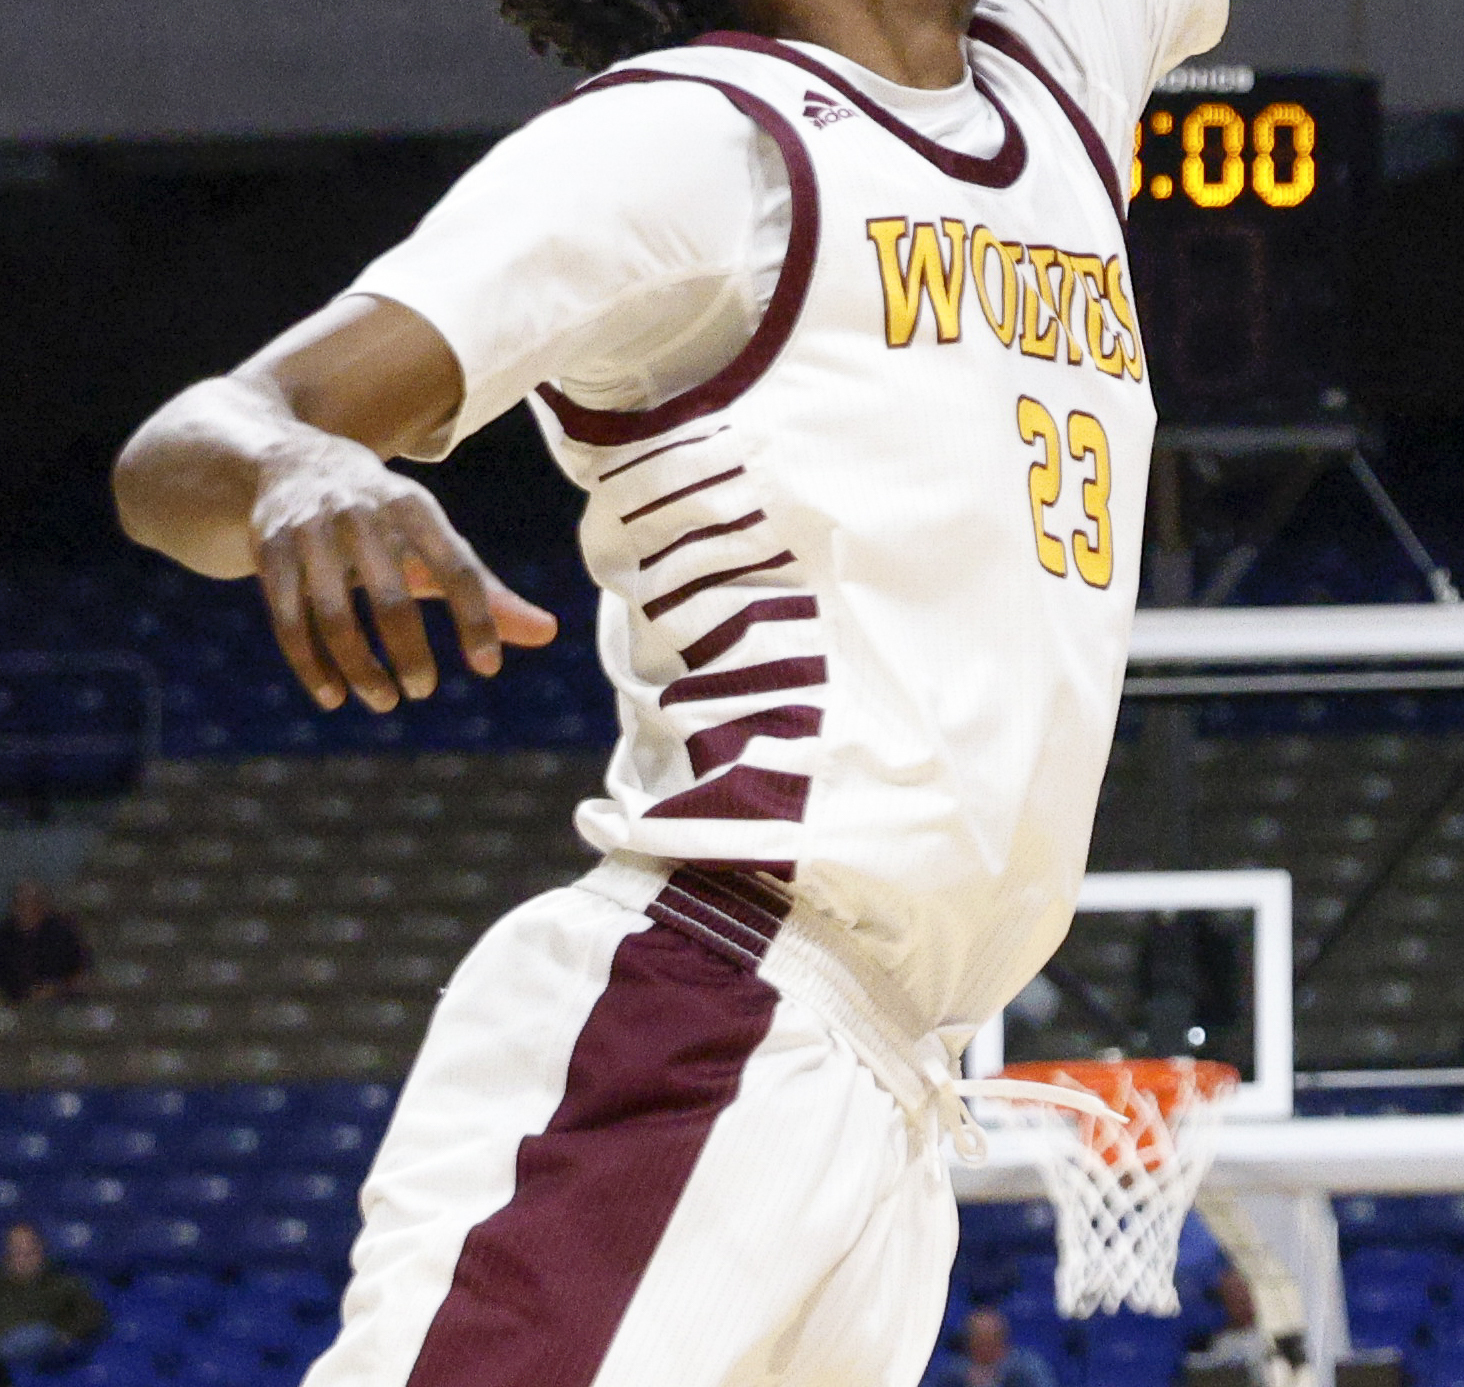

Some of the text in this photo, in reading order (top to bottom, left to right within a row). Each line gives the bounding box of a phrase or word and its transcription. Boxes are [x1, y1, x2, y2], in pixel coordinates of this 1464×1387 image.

[1129, 101, 1316, 208] :00
[866, 215, 1143, 383] WOLVES
[1017, 394, 1113, 590] 23
